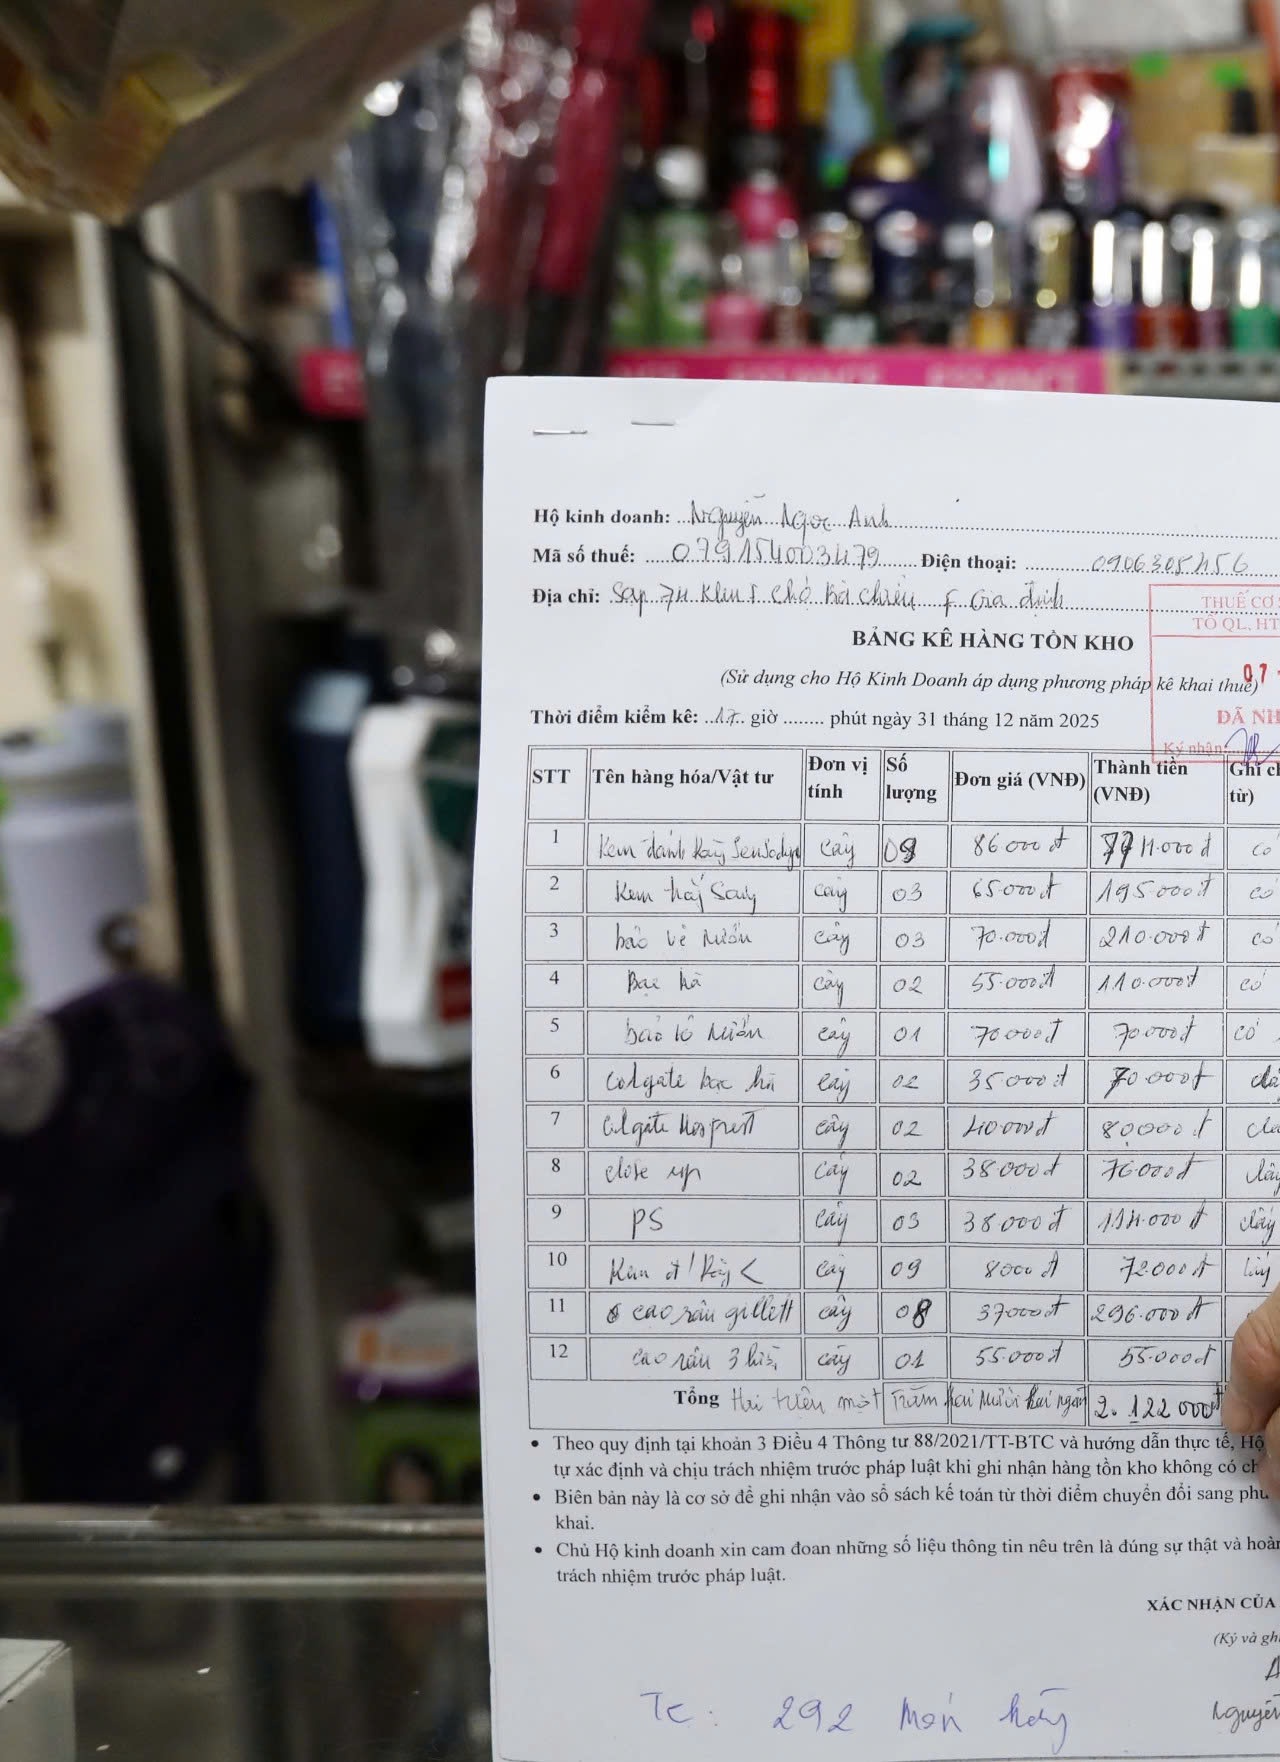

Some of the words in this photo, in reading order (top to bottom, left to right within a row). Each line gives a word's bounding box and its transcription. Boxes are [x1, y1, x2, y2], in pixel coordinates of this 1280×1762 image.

[533, 507, 560, 528] Hộ
[565, 508, 605, 524] kinh
[610, 508, 671, 524] doanh:
[532, 547, 562, 564] Mã
[566, 543, 586, 564] số
[590, 543, 635, 564] thuế:
[920, 552, 962, 573] Điện
[966, 554, 1017, 574] thoại:
[531, 587, 563, 608] Địa
[567, 587, 600, 604] chỉ:
[1256, 617, 1277, 630] HT
[851, 625, 916, 648] BẢNG
[921, 626, 953, 648] KÊ
[958, 627, 1025, 649] HÀNG
[1029, 629, 1079, 650] TỒN
[1083, 634, 1135, 652] KHO
[720, 668, 750, 688] (Sử
[752, 668, 797, 689] dụng
[800, 669, 831, 686] cho
[834, 670, 862, 689] Hộ
[865, 670, 907, 687] Kinh
[910, 671, 968, 688] Doanh
[971, 672, 994, 692] áp
[997, 672, 1040, 693] dụng
[1041, 673, 1108, 694] phương
[1109, 675, 1152, 697] pháp
[1156, 675, 1174, 691] kê
[1178, 676, 1214, 693] khai
[529, 709, 572, 725] Thời
[576, 704, 619, 725] điểm
[624, 704, 667, 725] kiểm
[672, 708, 699, 724] kê:
[750, 708, 779, 729] giờ
[829, 709, 868, 730] phút
[871, 710, 913, 731] ngày
[917, 711, 936, 727] 31
[942, 711, 989, 732] tháng
[995, 712, 1014, 728] 12
[1018, 713, 1054, 728] năm
[1058, 712, 1100, 729] 2025
[1216, 706, 1245, 725] ĐÃ
[807, 755, 845, 772] Đơn
[850, 756, 868, 776] vị
[886, 752, 908, 773] Số
[1093, 758, 1152, 775] Thành
[1156, 756, 1189, 776] tiền
[531, 768, 572, 785] STT
[591, 767, 626, 785] Tên
[631, 768, 675, 789] hàng
[679, 768, 750, 789] hóa/Vật
[753, 770, 775, 785] tư
[953, 770, 992, 787] Đơn
[996, 771, 1023, 791] giá
[1028, 771, 1086, 792] (VNĐ)
[807, 783, 844, 799] tính
[885, 783, 938, 805] lượng
[1093, 785, 1151, 806] (VNĐ)
[1228, 787, 1255, 807] từ)
[552, 828, 559, 844] 1
[549, 875, 560, 891] 2
[549, 922, 559, 938] 3
[548, 969, 560, 985] 4
[549, 1017, 560, 1033] 5
[549, 1063, 561, 1080] 6
[550, 1110, 561, 1126] 7
[551, 1157, 561, 1173] 8
[551, 1203, 562, 1220] 9
[548, 1251, 568, 1267] 10
[549, 1297, 565, 1313] 11
[549, 1343, 569, 1359] 12
[672, 1385, 720, 1409] Tổng
[552, 1434, 595, 1451] Theo
[599, 1439, 629, 1456] quy
[634, 1435, 671, 1455] định
[675, 1435, 696, 1455] tại
[701, 1435, 752, 1452] khoản
[757, 1435, 767, 1451] 3
[772, 1431, 813, 1451] Điều
[817, 1435, 828, 1450] 4
[832, 1434, 887, 1453] Thông
[891, 1435, 910, 1449] tư
[914, 1431, 1055, 1452] 88/2021/TT-BTC
[1059, 1434, 1080, 1450] và
[1083, 1434, 1136, 1454] hướng
[1140, 1431, 1170, 1450] dẫn
[1174, 1433, 1211, 1452] thực
[1215, 1431, 1235, 1451] tế,
[1241, 1434, 1265, 1452] Hộ
[555, 1514, 595, 1531] khai.
[556, 1567, 597, 1583] trách
[601, 1568, 653, 1587] nhiệm
[656, 1568, 701, 1584] trước
[705, 1567, 746, 1587] pháp
[750, 1566, 786, 1585] luật.
[1146, 1595, 1183, 1612] XÁC
[1186, 1595, 1236, 1614] NHẬN
[1239, 1593, 1277, 1610] CỦA
[1213, 1631, 1239, 1648] (Ký
[1241, 1631, 1258, 1644] và
[772, 1695, 853, 1733] 292
